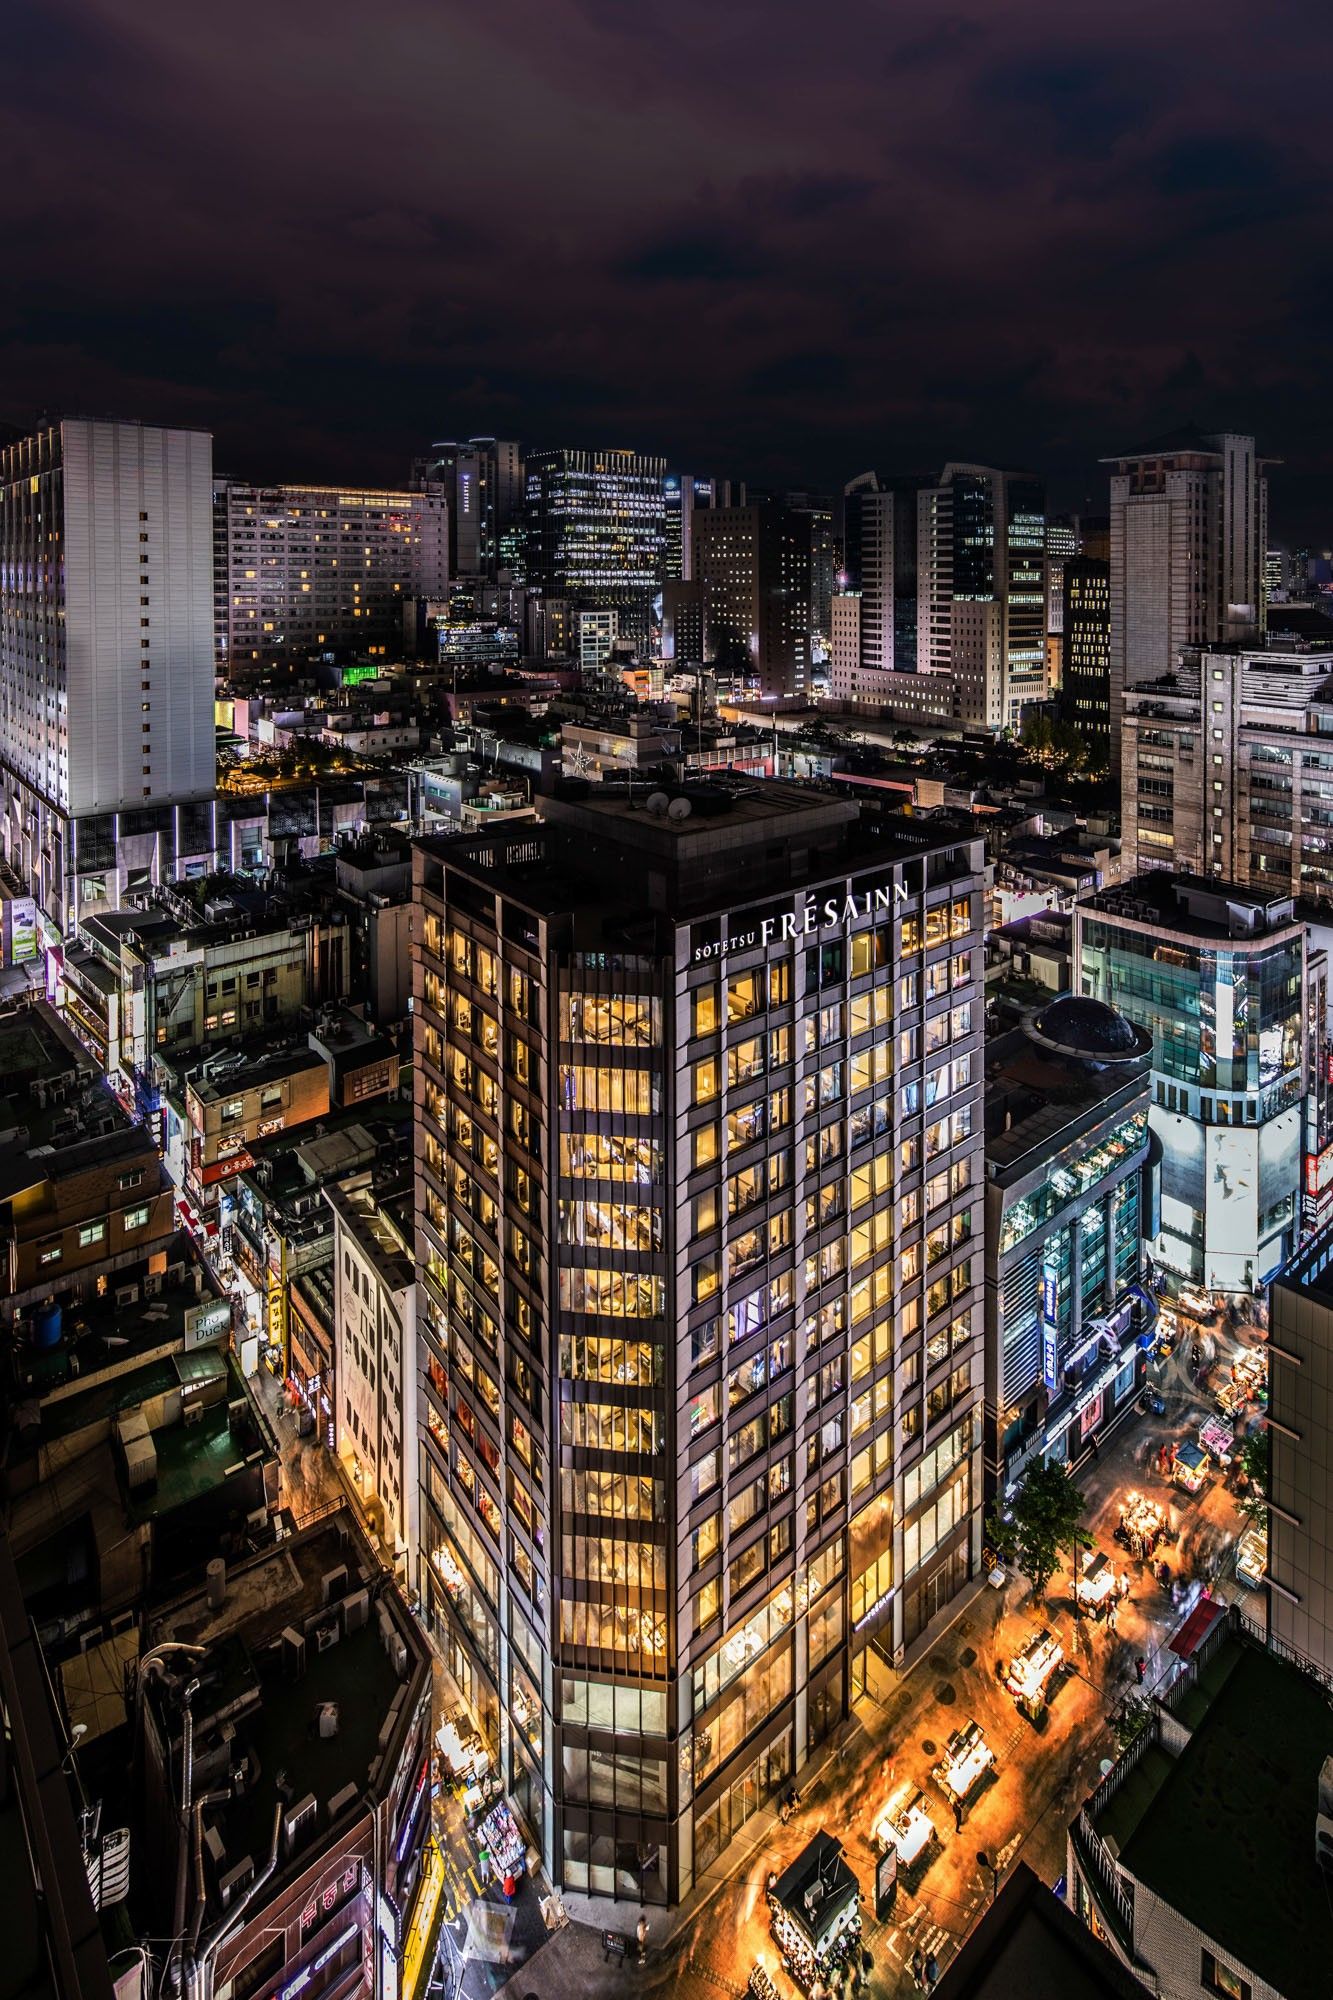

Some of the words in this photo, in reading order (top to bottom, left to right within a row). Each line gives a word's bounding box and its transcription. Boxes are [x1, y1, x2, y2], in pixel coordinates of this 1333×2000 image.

[695, 931, 755, 961] SOTETSU
[195, 1315, 219, 1330] Pho
[195, 1321, 228, 1341] Duck
[301, 1863, 359, 1928] 부동산
